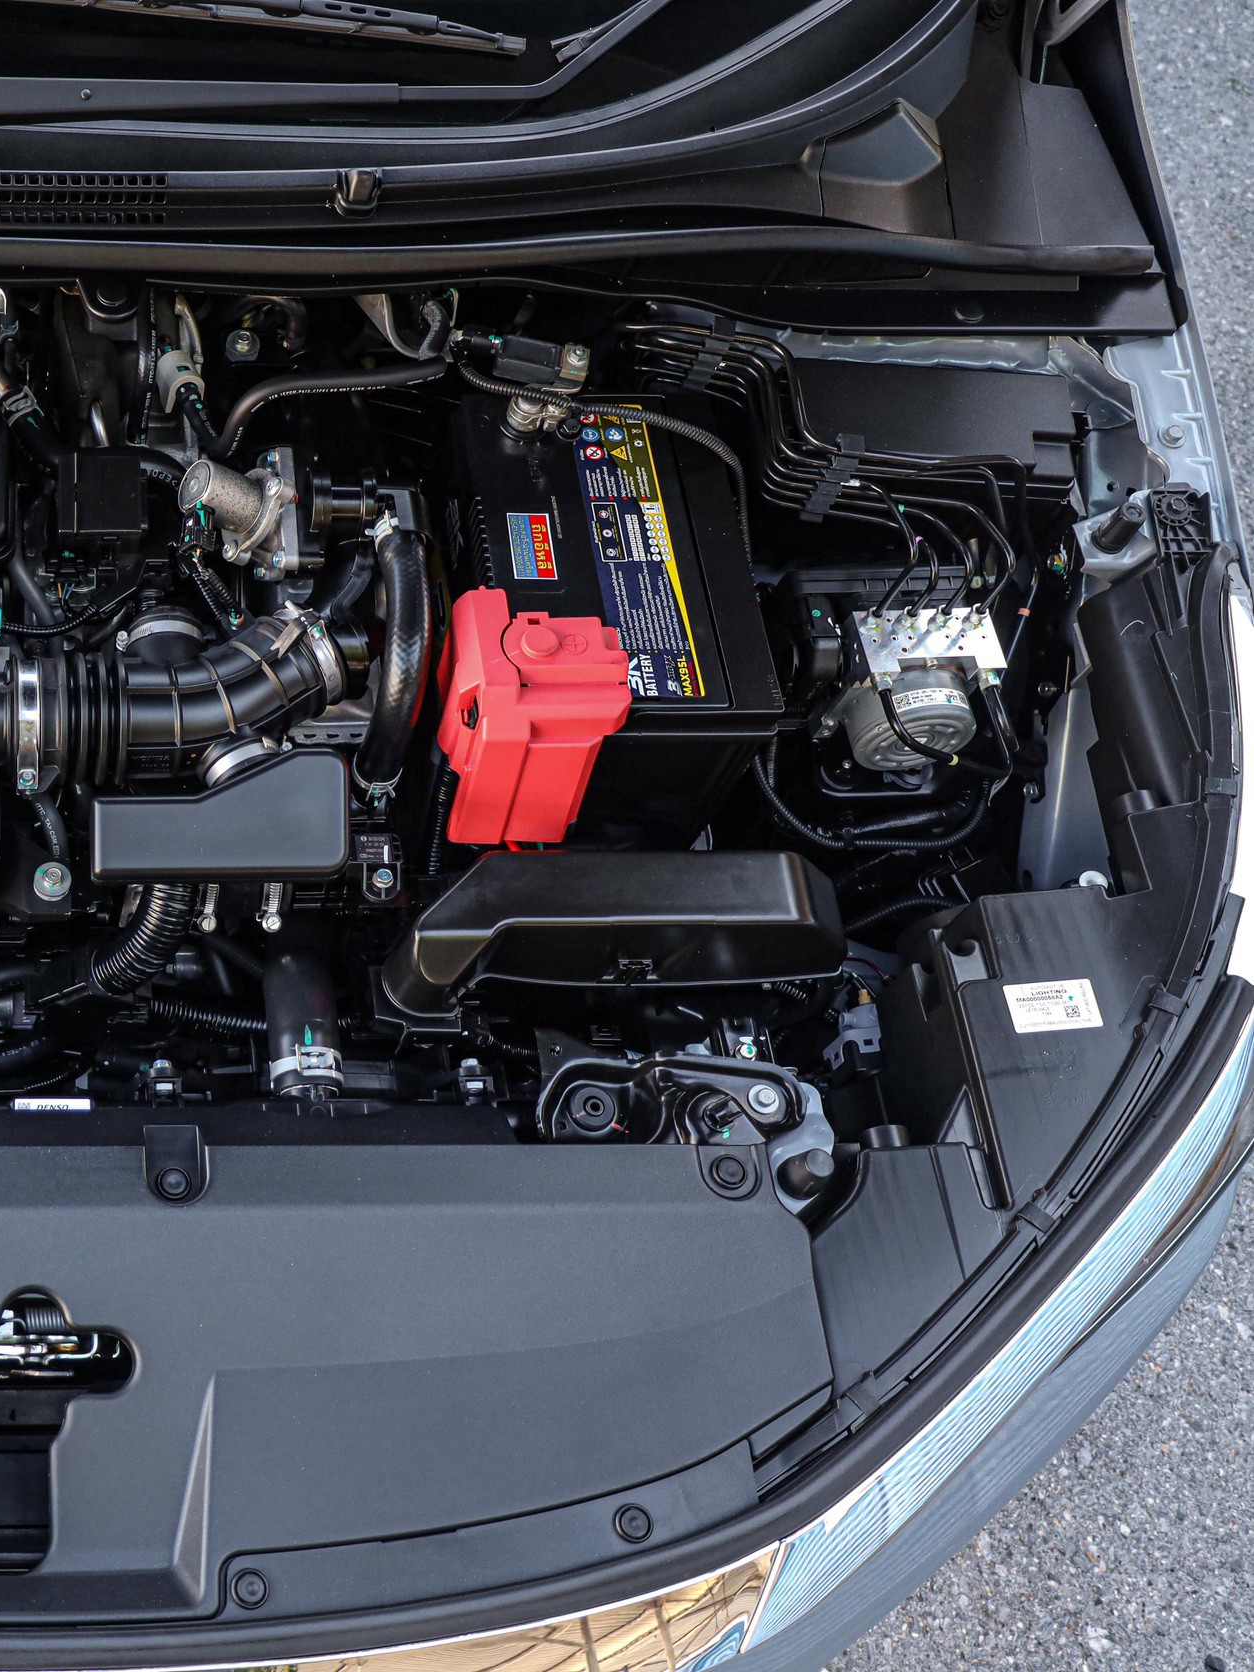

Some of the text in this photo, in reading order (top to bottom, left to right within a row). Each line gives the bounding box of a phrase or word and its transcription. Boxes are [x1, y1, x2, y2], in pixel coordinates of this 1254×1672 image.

[639, 654, 658, 696] BATTERY
[677, 655, 694, 696] MAX95L
[1031, 988, 1068, 996] LIGHTING
